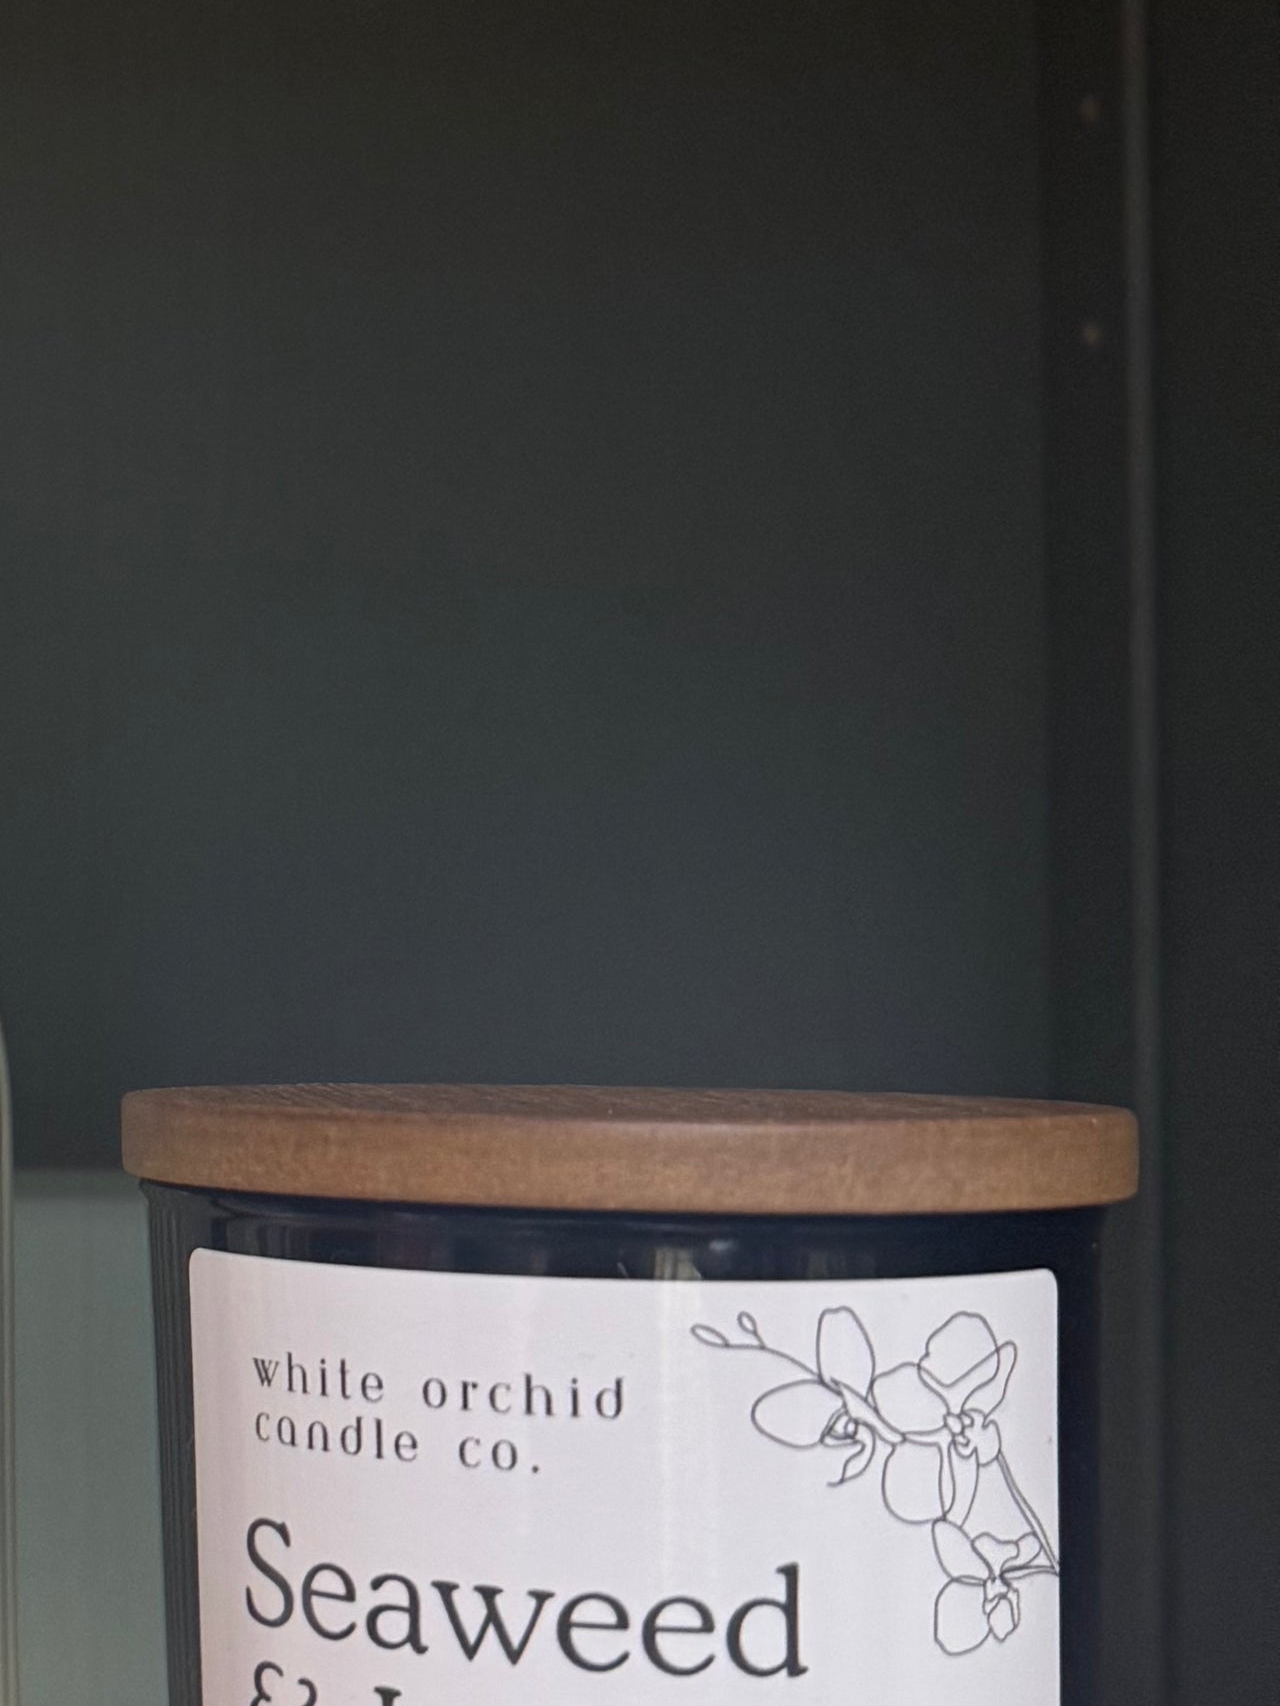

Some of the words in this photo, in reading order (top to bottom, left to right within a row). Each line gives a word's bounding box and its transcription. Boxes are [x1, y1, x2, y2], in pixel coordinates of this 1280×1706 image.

[251, 1351, 385, 1403] white
[420, 1376, 626, 1421] orchid
[254, 1410, 420, 1464] candle
[457, 1435, 543, 1475] co.
[244, 1516, 811, 1681] Seaweed
